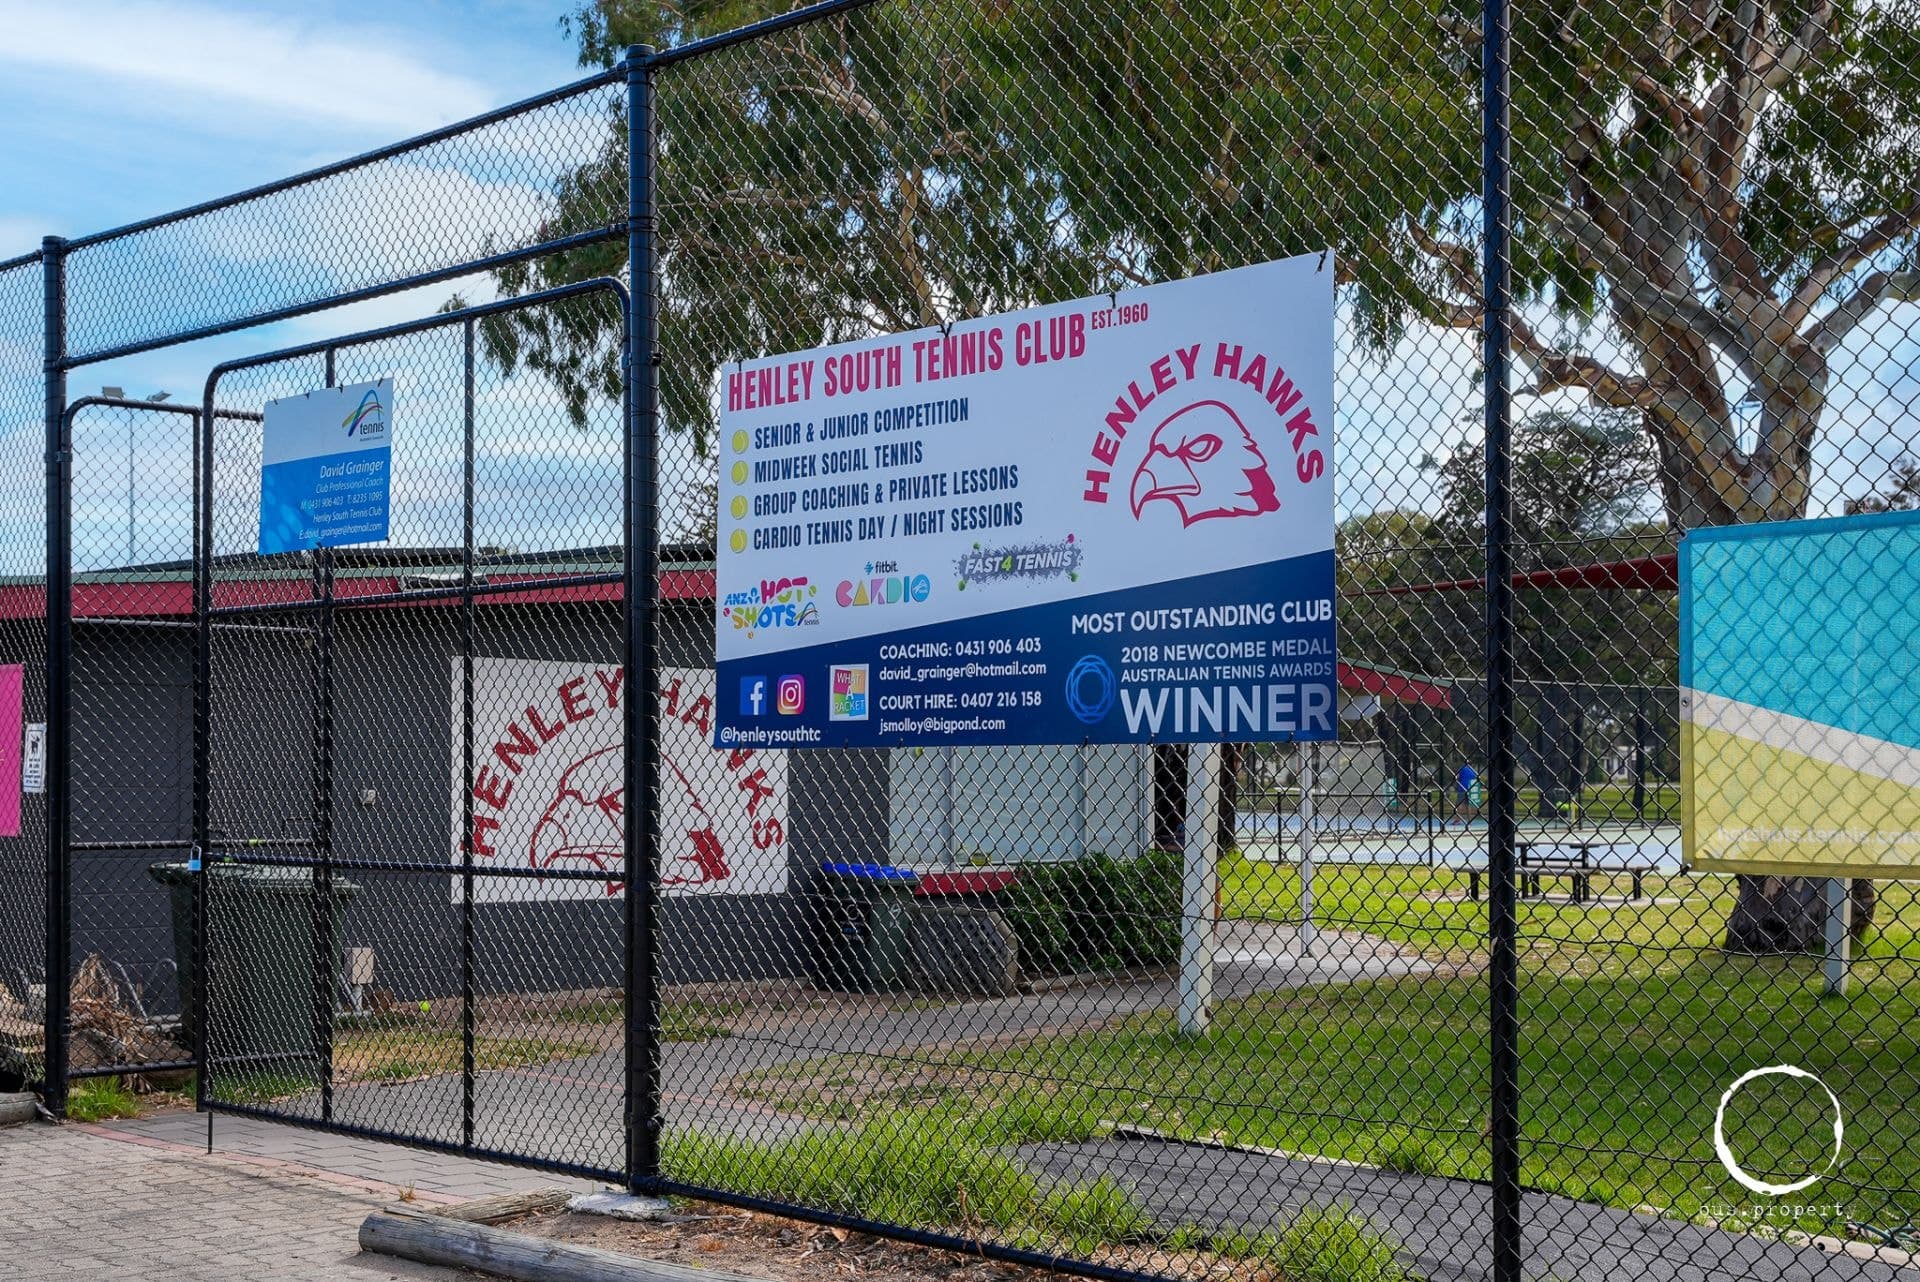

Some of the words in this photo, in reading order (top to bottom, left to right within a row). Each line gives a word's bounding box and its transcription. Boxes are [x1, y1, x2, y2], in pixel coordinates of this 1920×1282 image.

[729, 360, 814, 411] HENLEY
[824, 345, 901, 397] SOUTH
[913, 328, 1003, 383] TENNIS
[1015, 313, 1085, 366] CLUB
[1091, 302, 1148, 330] EST.1960
[360, 421, 384, 435] tennis
[754, 422, 801, 450] SENIOR
[806, 421, 815, 436] &
[820, 412, 868, 441] JUNIOR
[874, 398, 969, 439] COMPETITION
[1083, 343, 1201, 503] HENLEY
[1213, 342, 1324, 484] HAWKS
[320, 462, 345, 479] David
[346, 460, 384, 475] Grainger
[754, 454, 817, 484] MIDWEEK
[821, 447, 869, 475] SOCIAL
[874, 440, 923, 468] TENNIS
[315, 482, 329, 494] Club
[329, 478, 364, 492] Professional
[364, 477, 384, 488] Coach
[754, 491, 797, 517] GROUP
[802, 482, 869, 512] COACHING
[875, 483, 883, 497] &
[889, 472, 947, 502] PRIVATE
[953, 464, 1019, 495] LESSONS
[313, 512, 332, 524] Henley
[332, 510, 349, 521] South
[349, 508, 368, 519] Tennis
[368, 505, 383, 517] Club
[753, 524, 801, 550] CARDIO
[806, 517, 852, 545] TENNIS
[859, 512, 884, 540] DAY
[890, 514, 897, 538] /
[903, 509, 945, 536] NIGHT
[951, 501, 1023, 532] SESSIONS
[1016, 551, 1073, 570] TENNIS
[724, 592, 748, 606] ANZ
[760, 577, 808, 605] HOT
[835, 574, 931, 608] CARDIO
[732, 603, 797, 630] SHOTS
[1072, 612, 1125, 635] MOST
[1130, 603, 1275, 631] OUTSTANDING
[1280, 599, 1332, 623] CLUB
[879, 643, 952, 661] COACHING:
[955, 641, 985, 657] 0431
[988, 639, 1012, 655] 906
[1015, 638, 1041, 653] 403
[1121, 646, 1159, 663] 2018
[1164, 641, 1266, 662] NEWCOMBE
[1272, 638, 1332, 657] MEDAL
[836, 672, 863, 684] WHAT
[879, 661, 1046, 682] david_grainger@hotmail.com
[1121, 666, 1210, 683] AUSTRALIAN
[1213, 664, 1265, 680] TENNIS
[1269, 662, 1332, 678] AWARDS
[845, 685, 854, 701] A
[879, 694, 921, 710] COURT
[924, 693, 958, 709] HIRE:
[961, 692, 993, 708] 0407
[996, 691, 1018, 707] 216
[1021, 691, 1042, 706] 158
[834, 700, 865, 713] RACKET
[1120, 683, 1332, 734] WINNER
[720, 725, 821, 743] @henleysouthtc
[879, 716, 1005, 735] jsmolloy@bigpond.com
